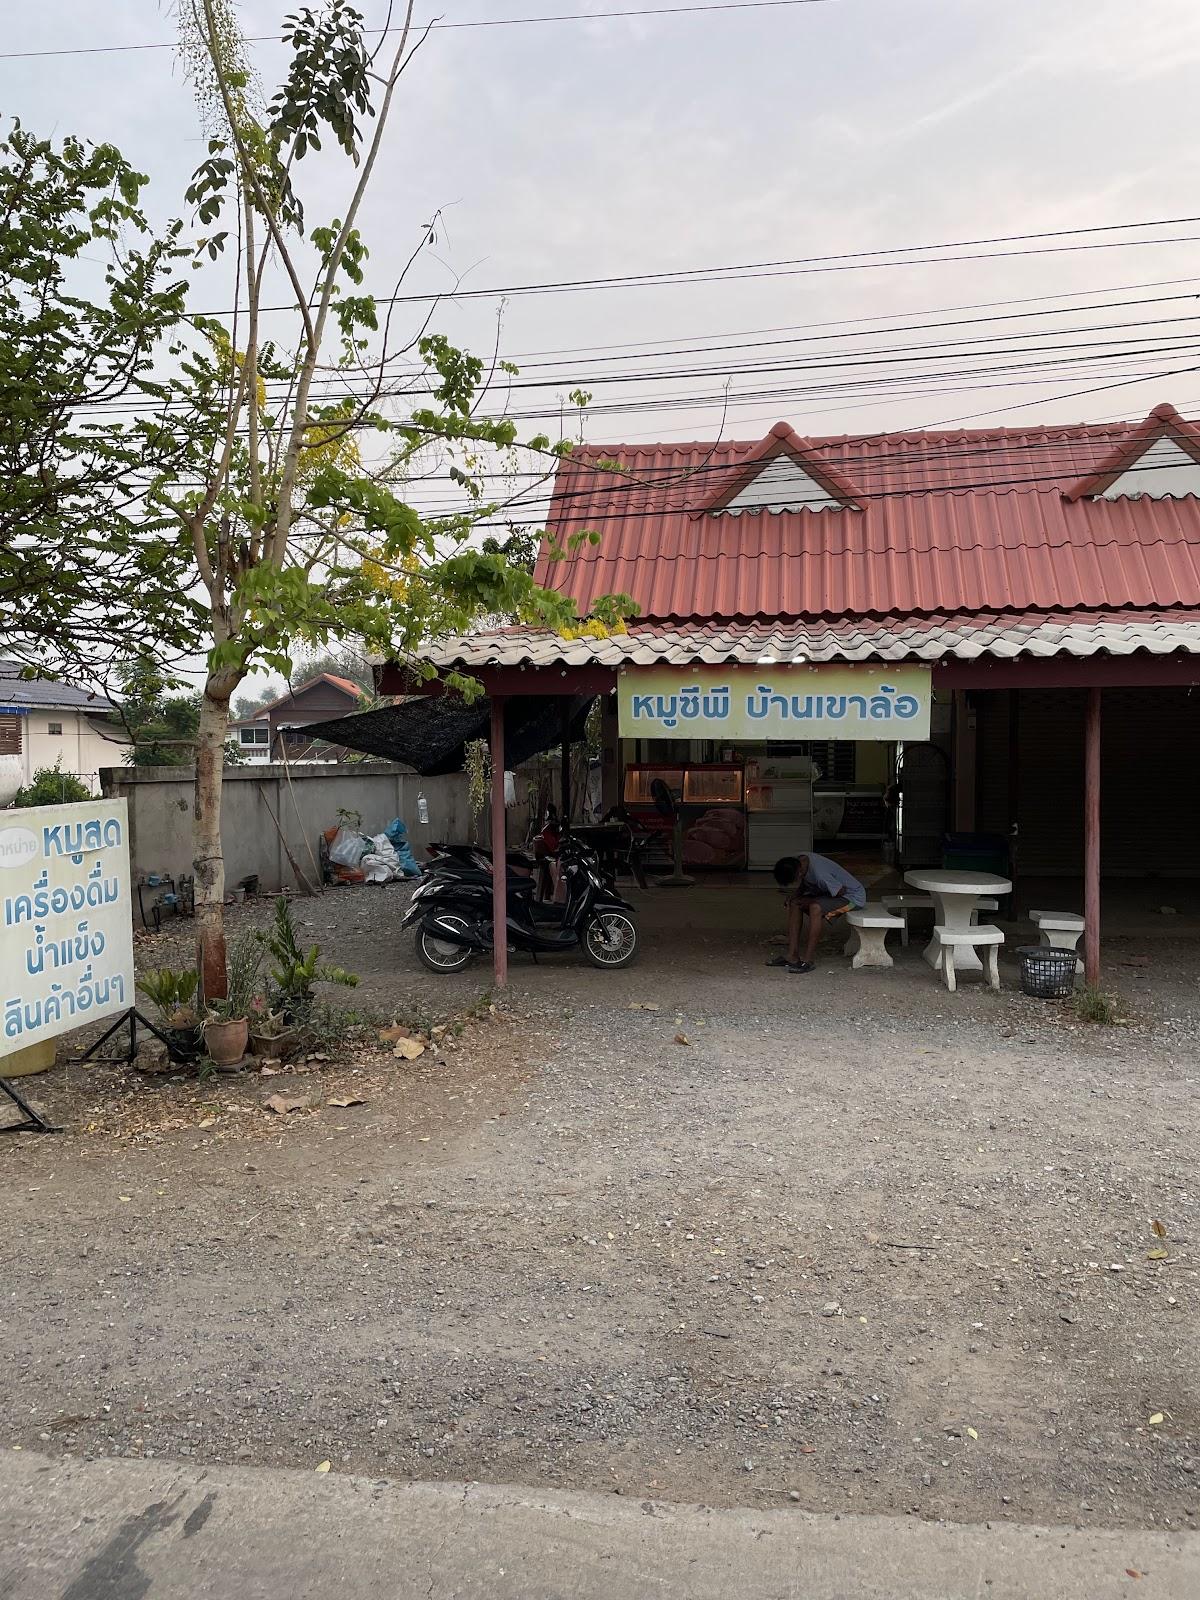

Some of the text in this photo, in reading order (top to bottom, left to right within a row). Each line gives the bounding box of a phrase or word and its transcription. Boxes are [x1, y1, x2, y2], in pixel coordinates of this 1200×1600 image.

[632, 685, 919, 727] หมูซีพี บ้านเขาล้อ
[43, 818, 122, 865] หมูสด
[5, 862, 119, 925] เครื่องดื่ม
[26, 920, 106, 976] น้ำแข็ง
[4, 964, 125, 1038] สินค้าอื่นๆ
